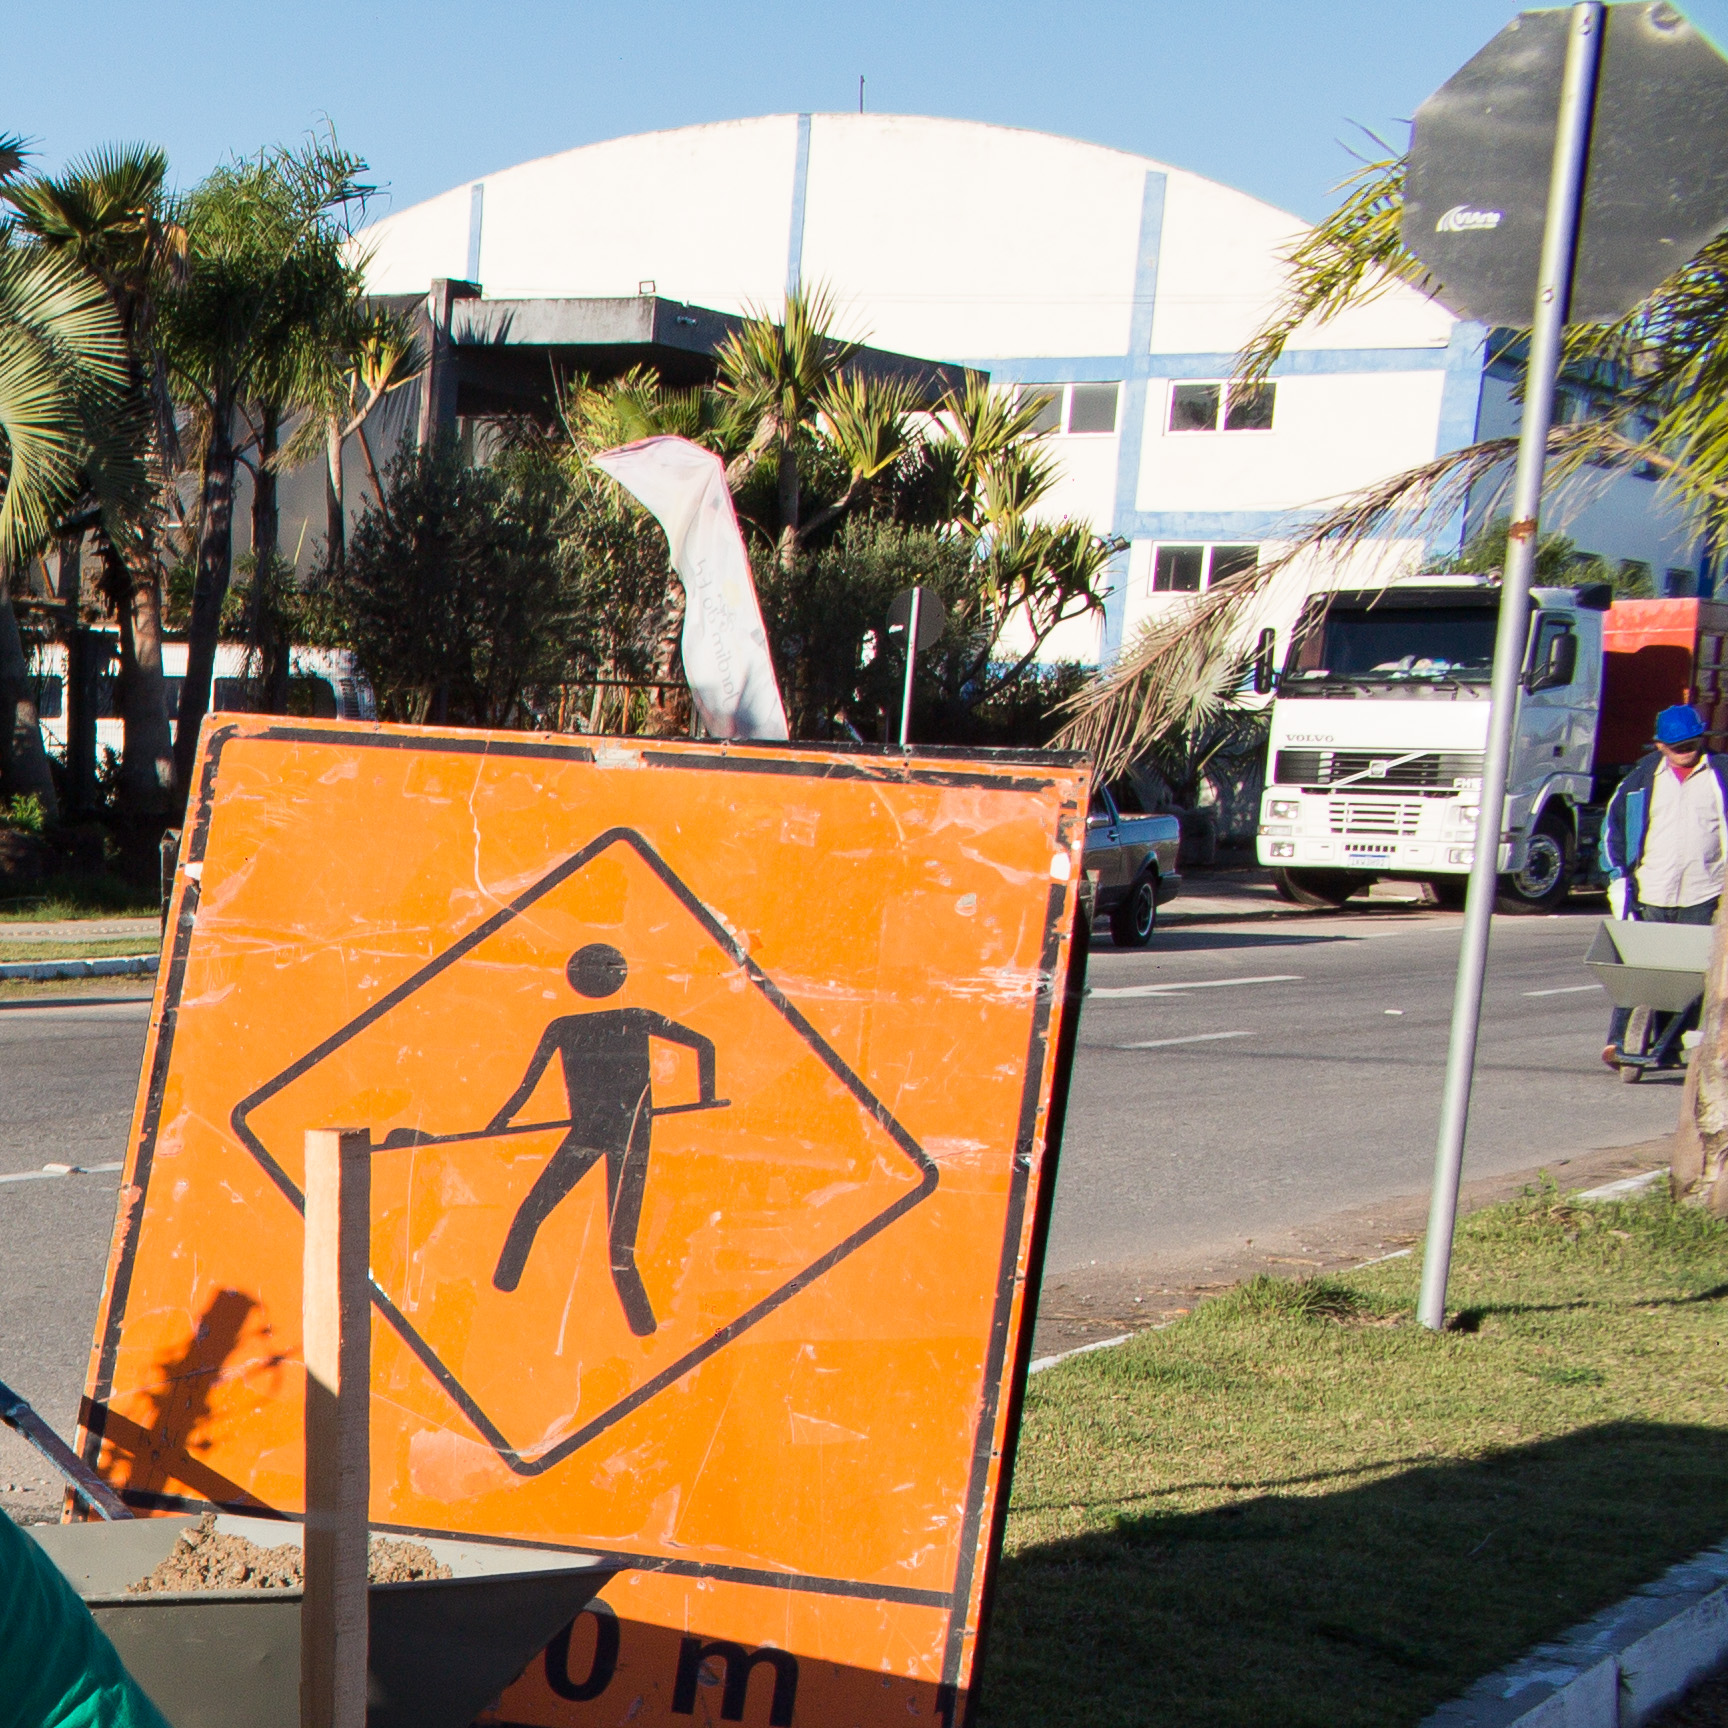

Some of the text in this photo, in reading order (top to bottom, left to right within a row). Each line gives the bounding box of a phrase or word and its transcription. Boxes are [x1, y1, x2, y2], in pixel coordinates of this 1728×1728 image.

[1285, 734, 1335, 743] VOLVO
[511, 1597, 800, 1728] 0 m
